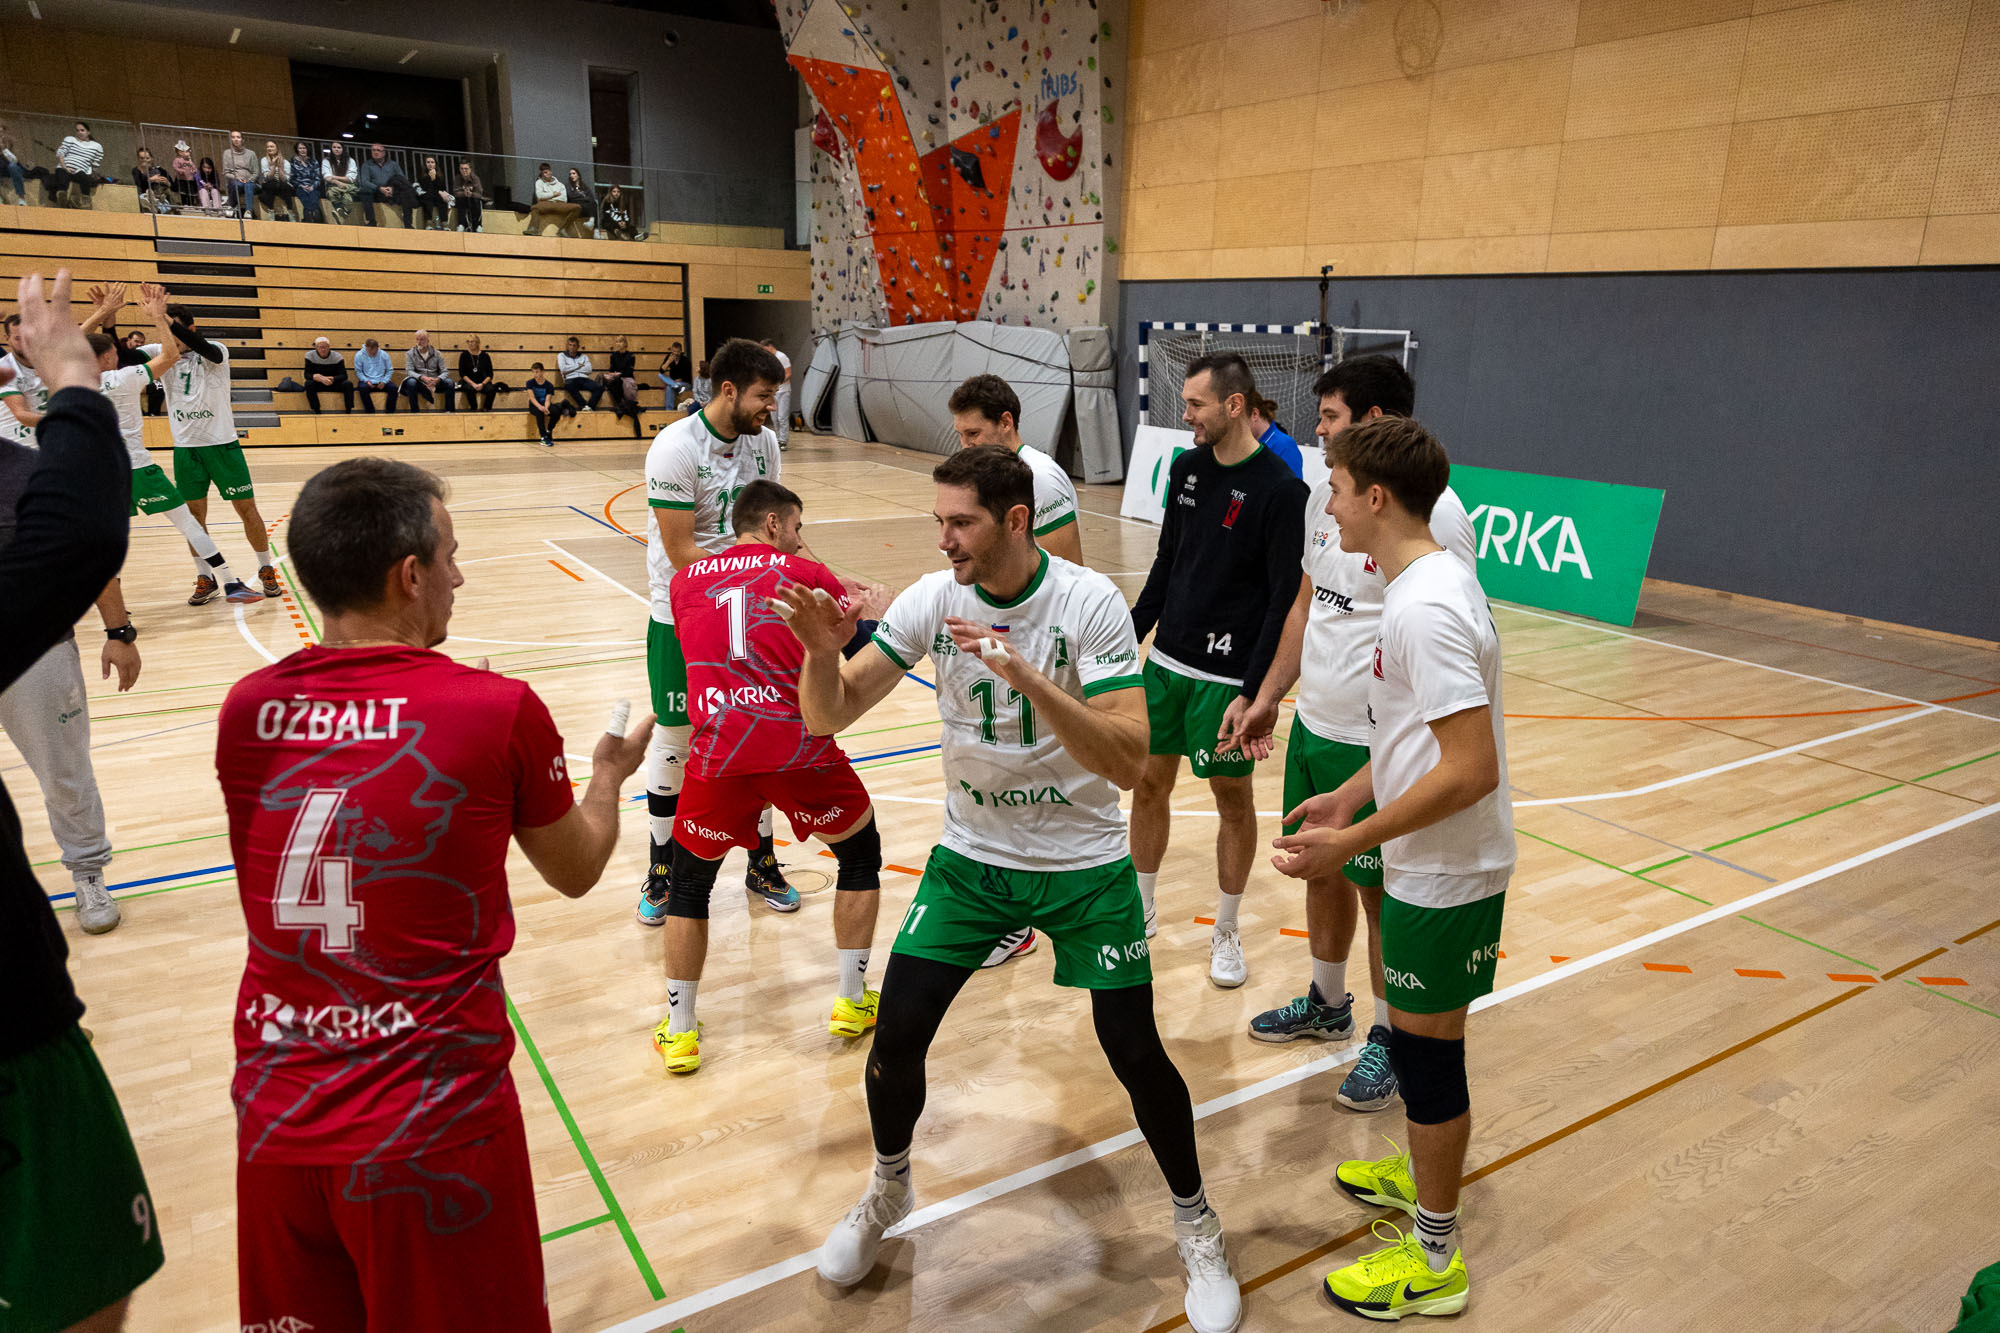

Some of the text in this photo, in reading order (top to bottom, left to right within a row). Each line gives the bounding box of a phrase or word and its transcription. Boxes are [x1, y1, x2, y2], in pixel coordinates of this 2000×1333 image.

[179, 372, 192, 396] 7
[186, 409, 215, 421] KRKA
[687, 553, 791, 579] TRAVNIK M.
[1314, 586, 1354, 613] TOTAL
[715, 585, 748, 661] 1
[1207, 632, 1233, 656] 14
[666, 691, 687, 713] 13
[729, 685, 783, 707] KRKA
[256, 694, 408, 741] OŽBALT
[968, 678, 1037, 748] 11
[1211, 751, 1245, 764] KRKA
[990, 785, 1074, 808] KRKA
[813, 806, 844, 826] KRKA
[698, 826, 735, 842] KRKA
[271, 787, 365, 953] 4
[1355, 854, 1384, 870] KRK
[900, 901, 929, 936] 11
[1123, 937, 1151, 963] KRK
[304, 1001, 420, 1040] KRKA
[131, 1193, 151, 1246] 9
